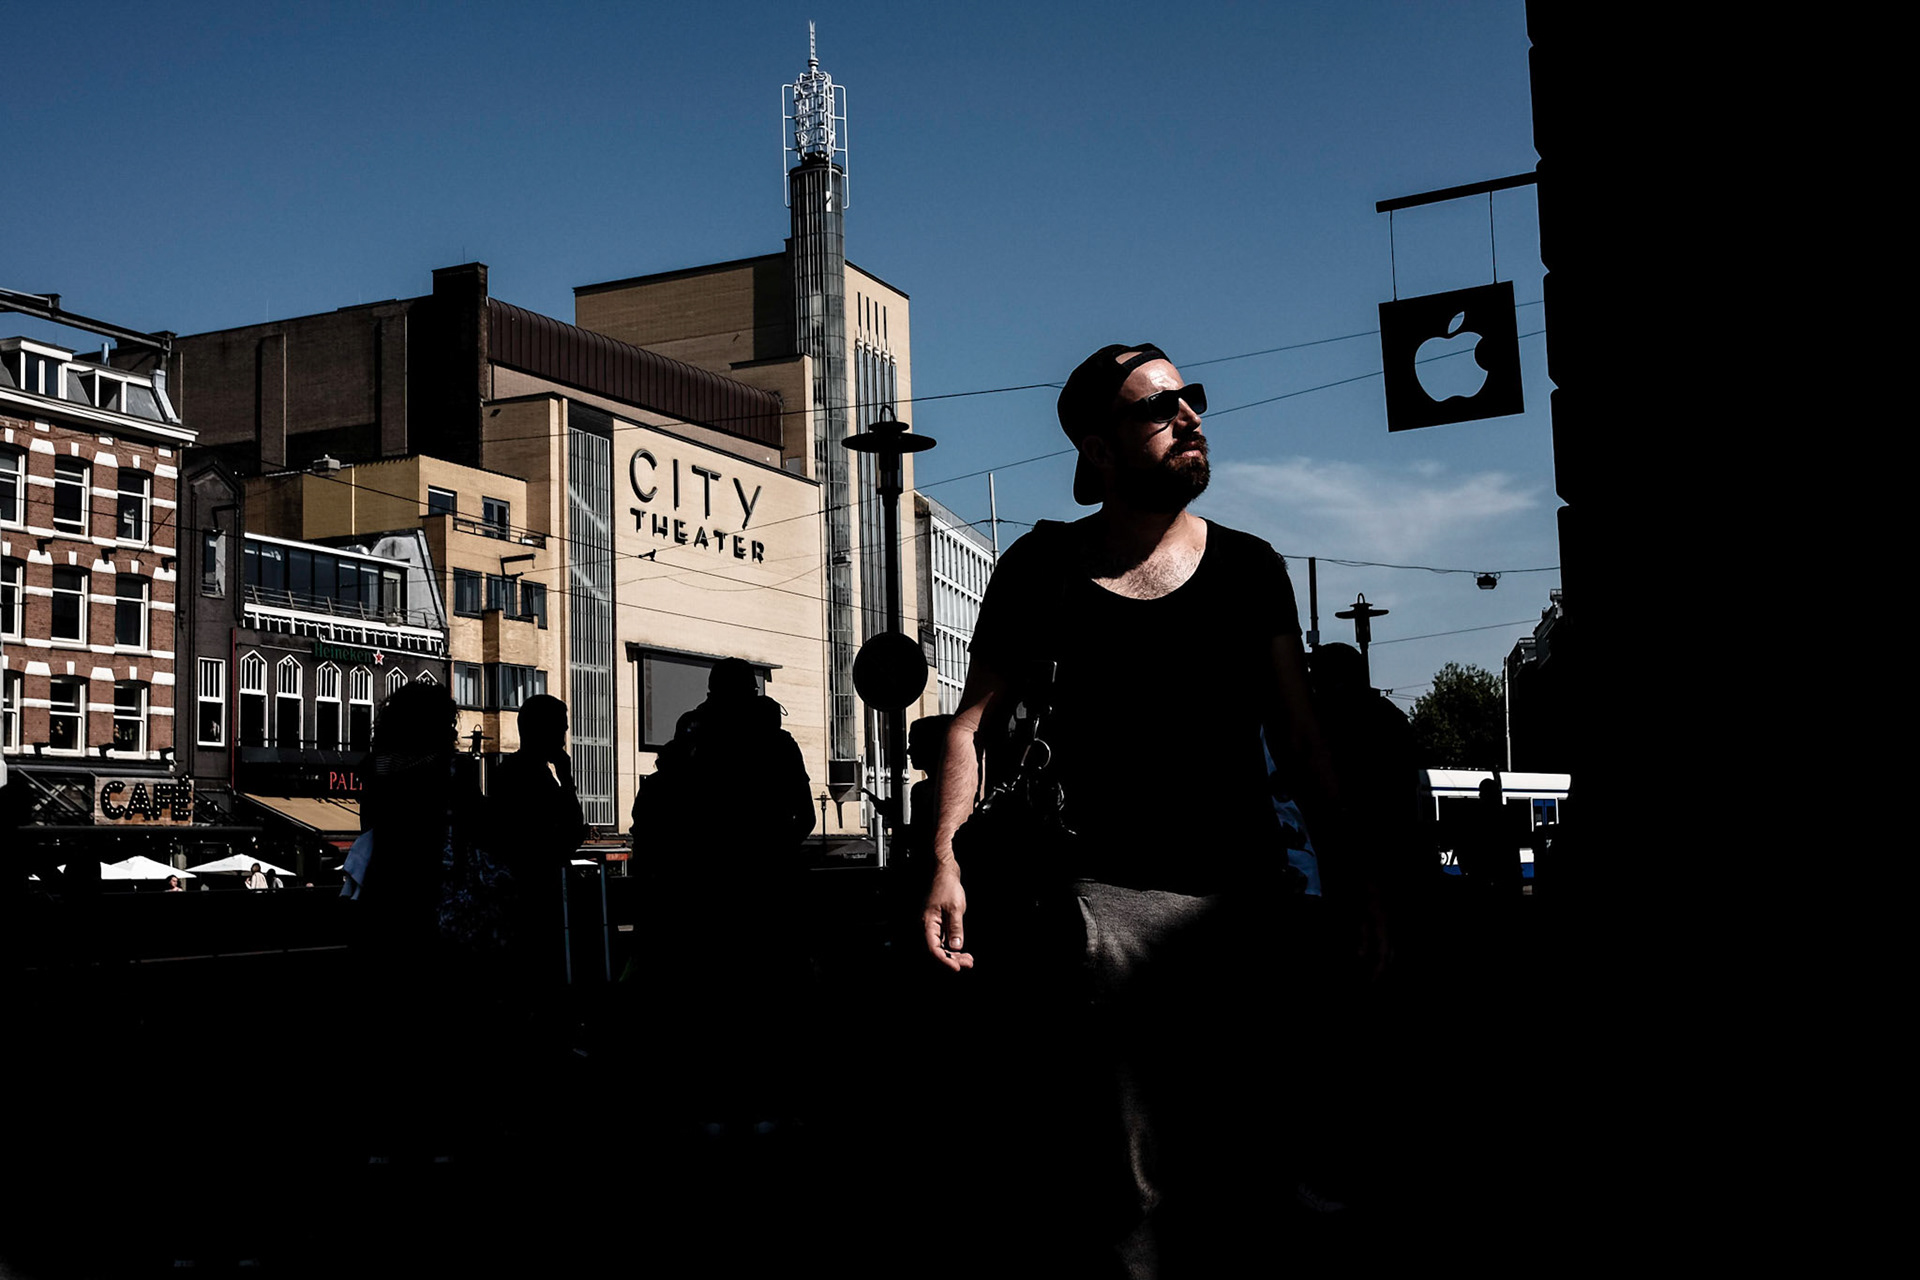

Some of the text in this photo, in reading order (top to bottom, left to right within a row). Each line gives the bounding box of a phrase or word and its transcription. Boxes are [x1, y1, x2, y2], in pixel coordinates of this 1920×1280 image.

[629, 448, 762, 530] CITY
[629, 507, 765, 564] THEATER
[314, 642, 372, 663] Heineken
[101, 772, 192, 821] CAFÉ
[329, 770, 363, 791] PAL
